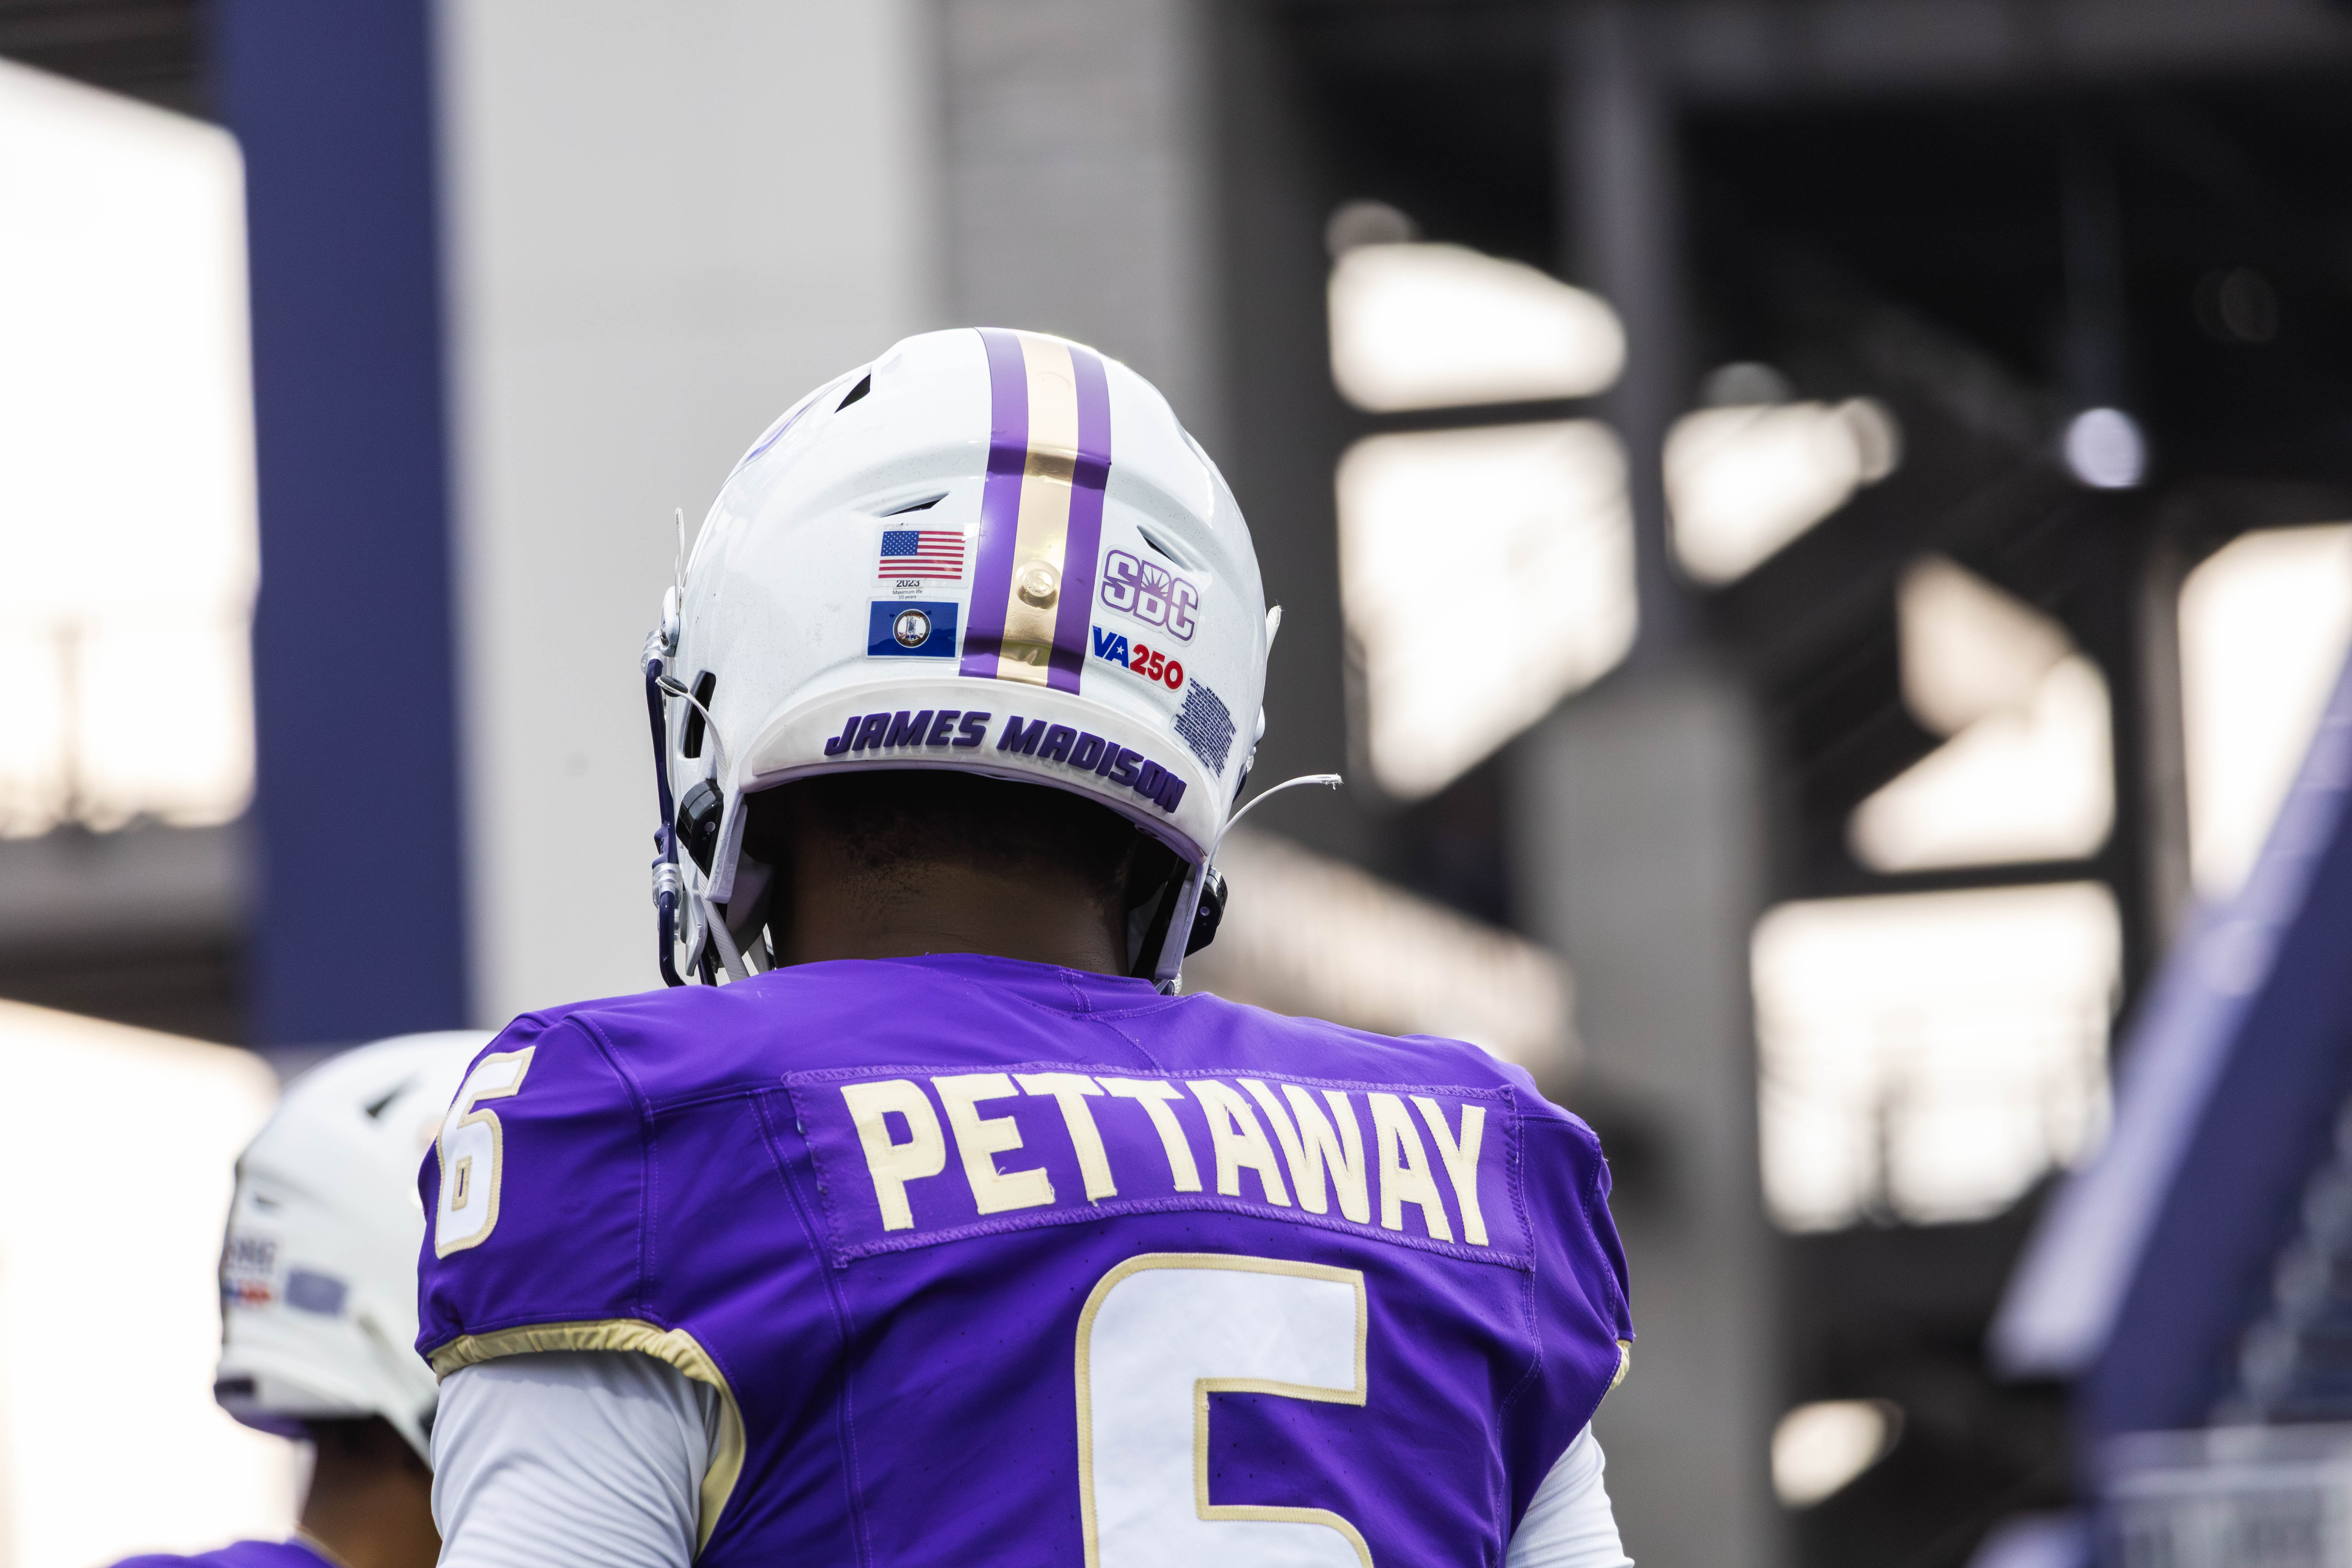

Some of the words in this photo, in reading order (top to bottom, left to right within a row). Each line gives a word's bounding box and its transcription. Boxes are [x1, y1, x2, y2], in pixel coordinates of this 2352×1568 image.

[824, 710, 992, 756] JAMES
[996, 715, 1187, 813] MADISON
[1207, 687, 1230, 716] WARNING
[435, 1046, 536, 1260] 6
[840, 1072, 1489, 1246] PETTAWAY
[1075, 1253, 1374, 1568] 6
